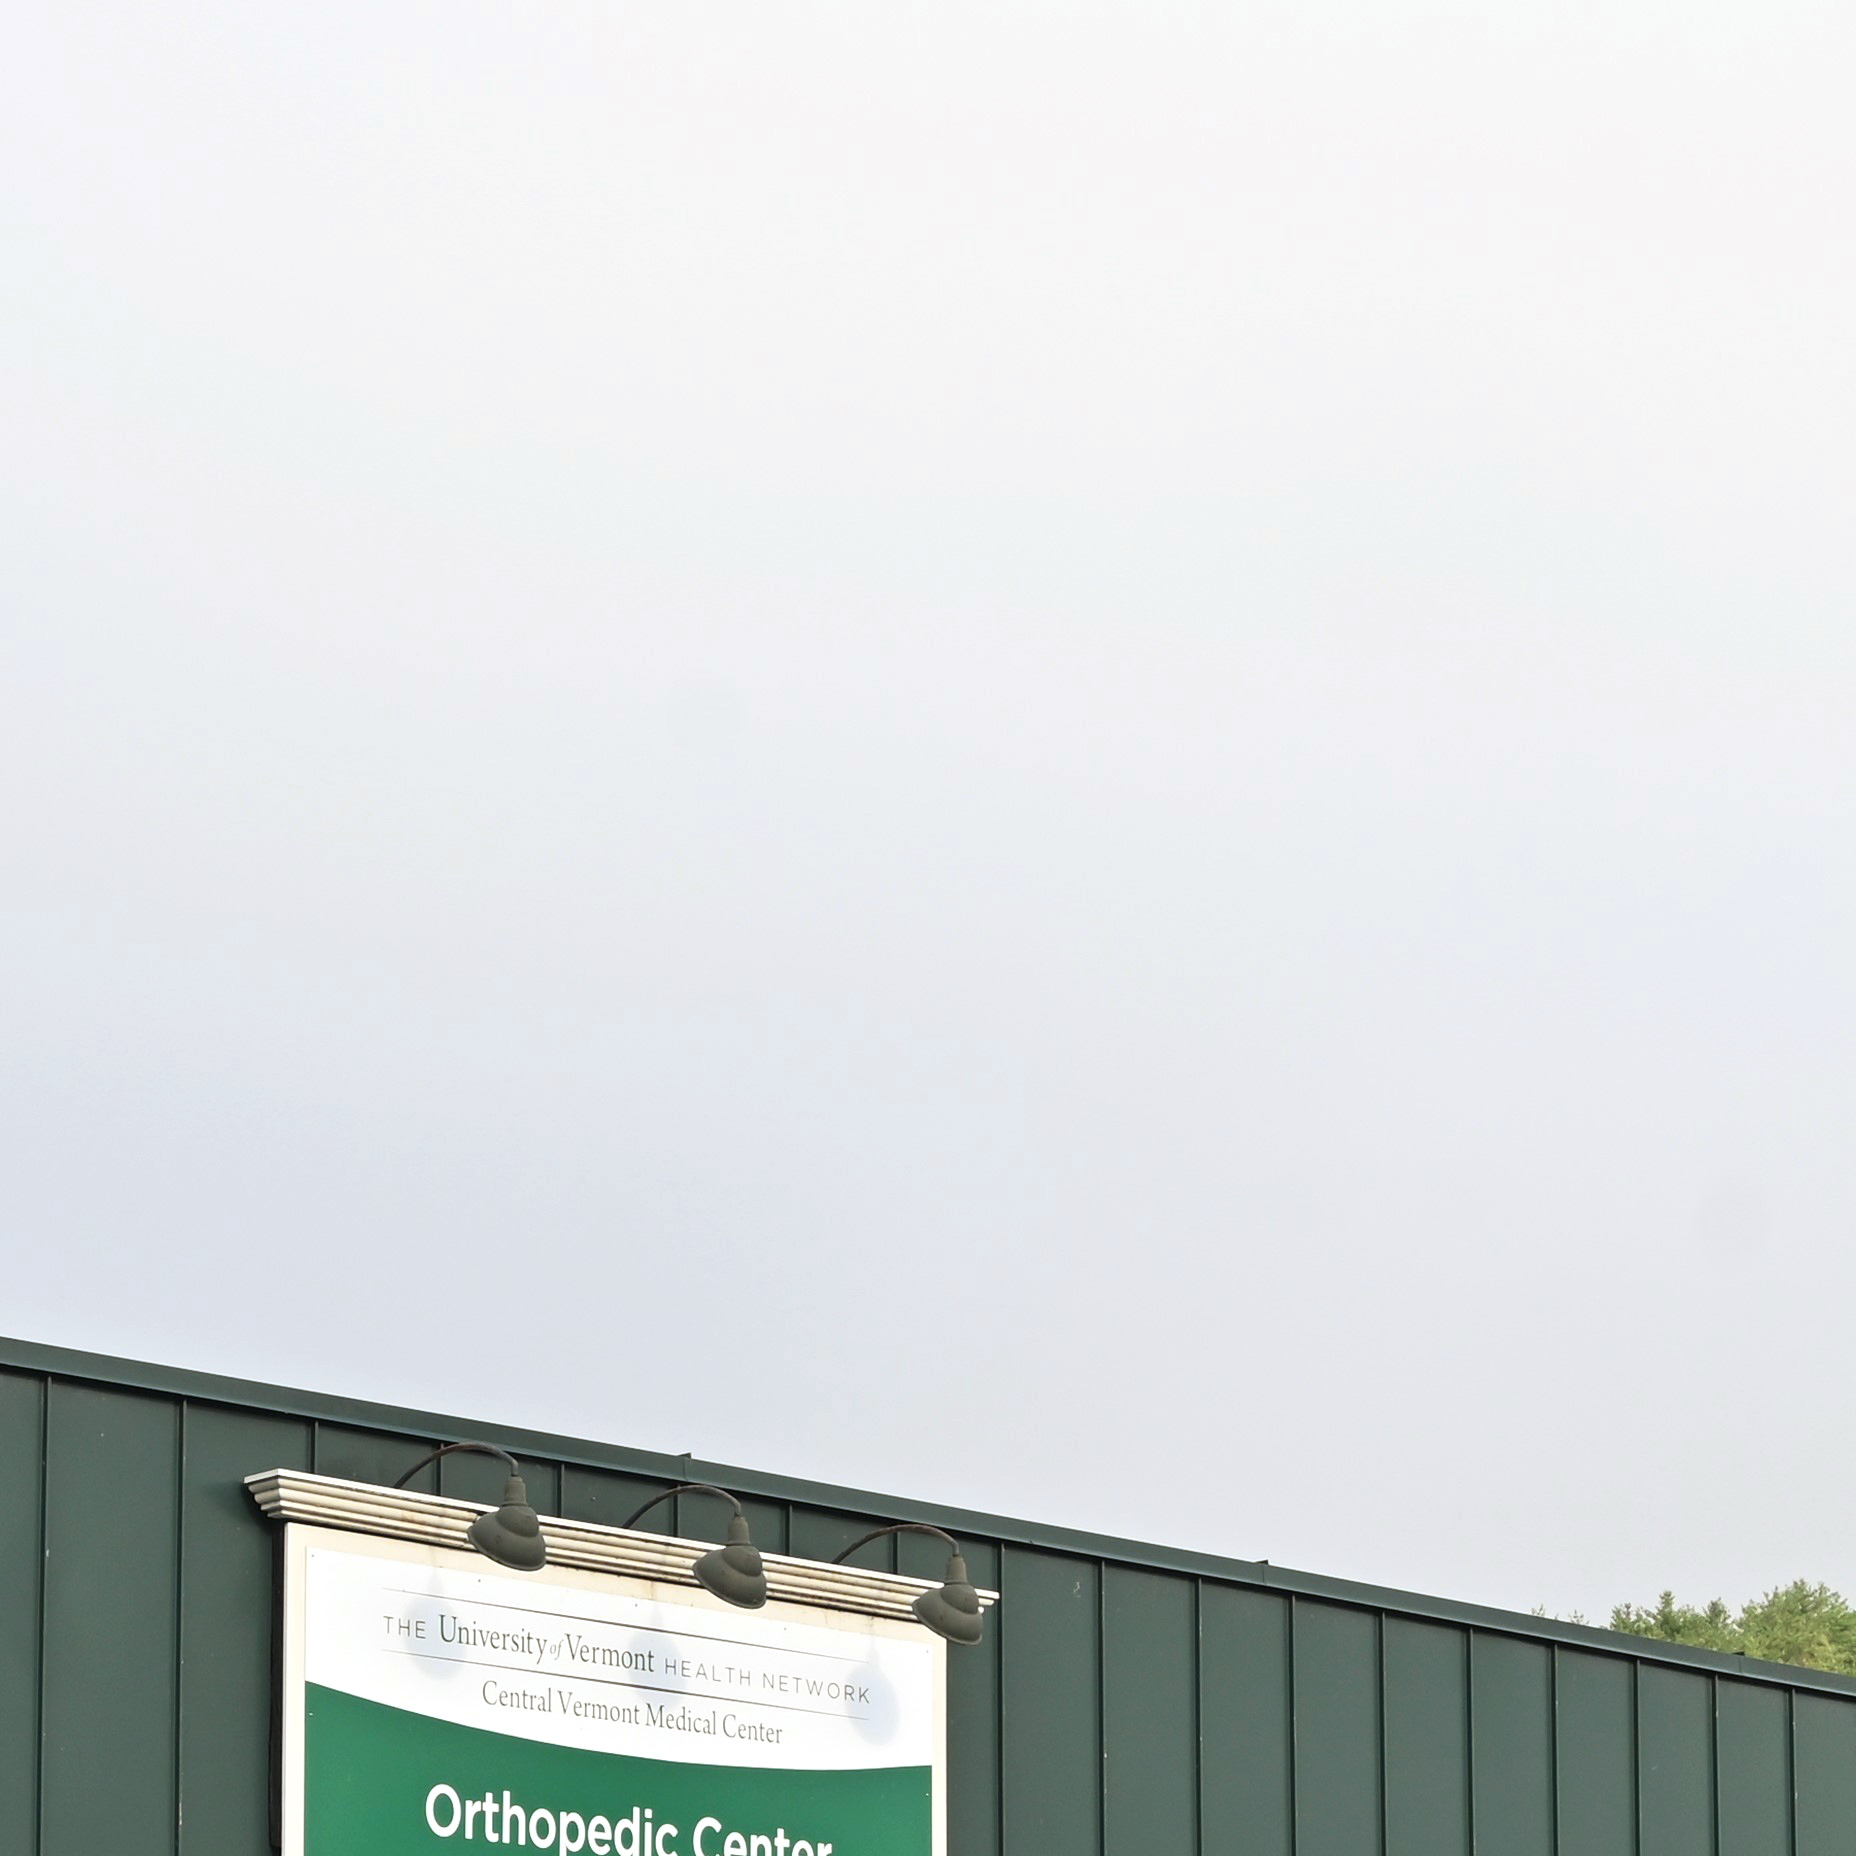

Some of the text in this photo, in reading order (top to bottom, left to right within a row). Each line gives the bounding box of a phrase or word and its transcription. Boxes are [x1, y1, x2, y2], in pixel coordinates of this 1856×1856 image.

[383, 1614, 871, 1705] THE University of Vermont HEALTH NETWORK
[482, 1680, 784, 1745] Central Vermont Medical Center
